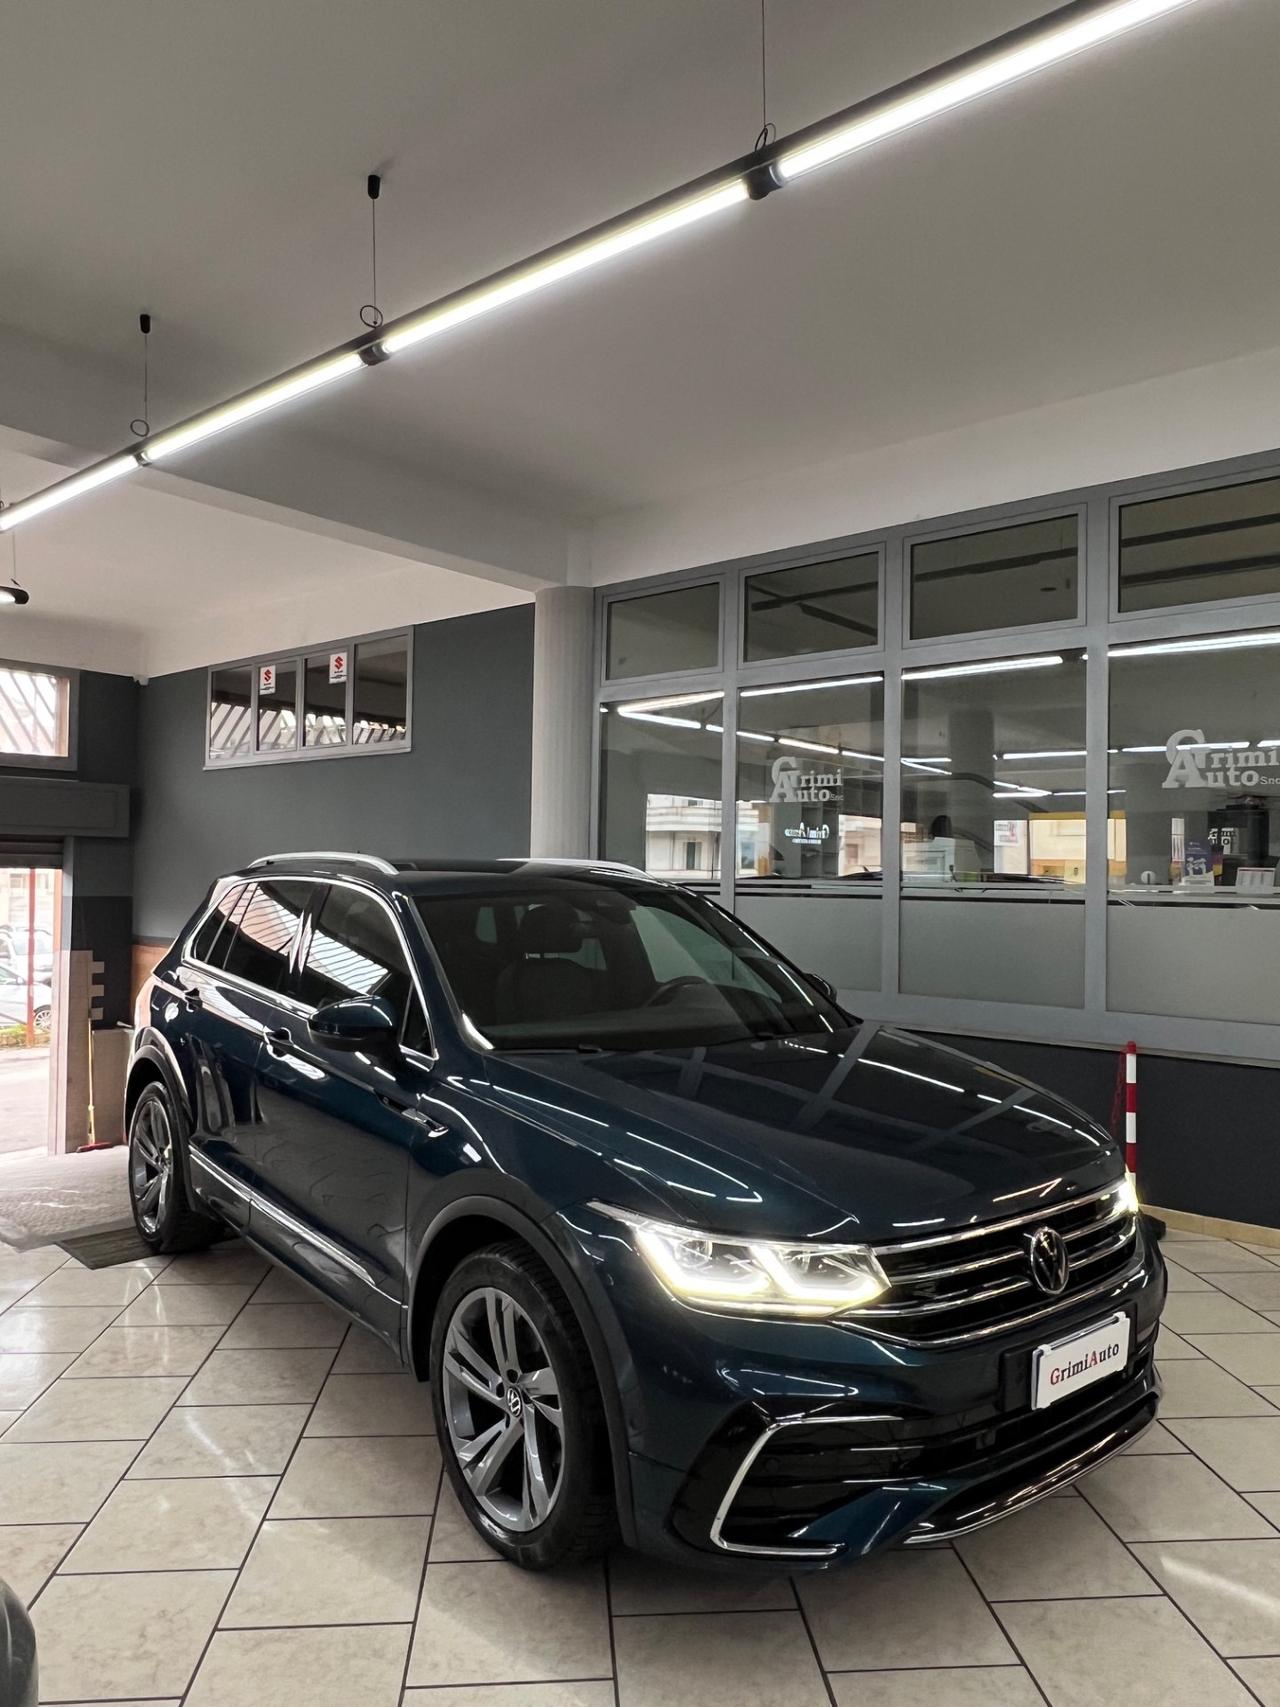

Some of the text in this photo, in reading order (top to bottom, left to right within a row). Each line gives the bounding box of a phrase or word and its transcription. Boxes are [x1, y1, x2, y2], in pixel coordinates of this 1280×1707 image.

[769, 771, 830, 802] Auto
[771, 756, 843, 788] Grimi
[1162, 749, 1260, 789] Auto
[1050, 1343, 1119, 1385] GrimiAuto
